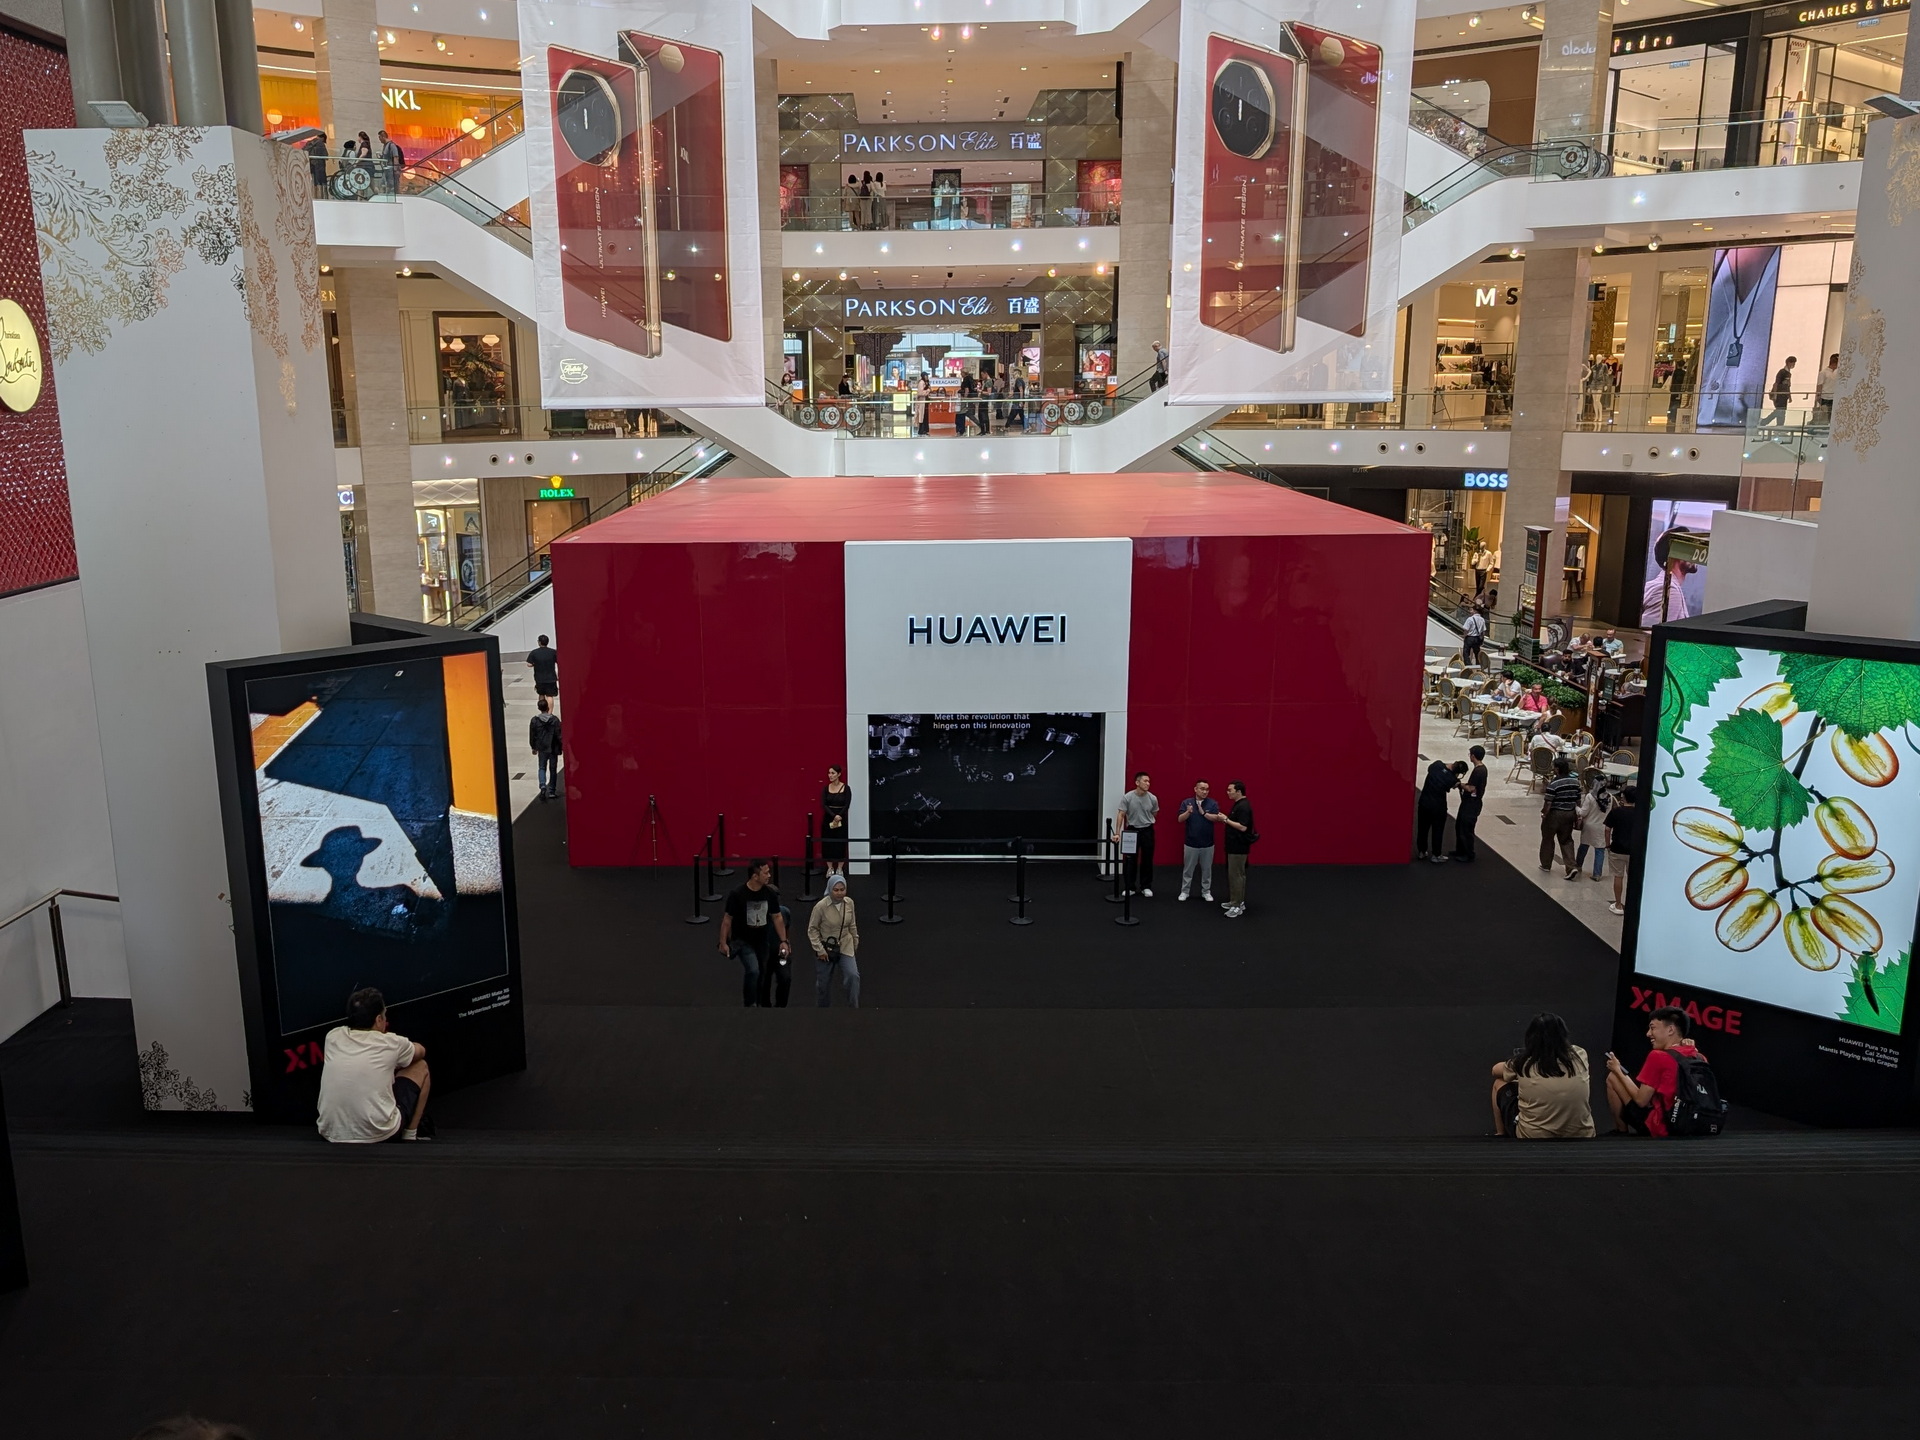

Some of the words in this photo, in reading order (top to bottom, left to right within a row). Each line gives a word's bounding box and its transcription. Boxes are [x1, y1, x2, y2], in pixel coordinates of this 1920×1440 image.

[1799, 3, 1857, 22] CHARLES
[1865, 1, 1873, 10] &
[844, 134, 956, 153] PARKSON
[958, 131, 999, 150] Elite
[1009, 132, 1042, 149] 百盛
[846, 298, 955, 317] PARKSON
[958, 296, 999, 315] Elite
[1007, 297, 1040, 314] 百盛
[1464, 472, 1508, 488] BOSS
[540, 489, 574, 498] ROLEX
[908, 614, 1067, 646] HUAWEI
[933, 722, 958, 730] hinges
[1838, 1037, 1864, 1048] HUAWEI
[1864, 1043, 1879, 1051] Pura
[1818, 1045, 1838, 1054] Mantis
[1839, 1051, 1861, 1060] Playing
[1877, 1059, 1898, 1068] Grapes
[1875, 1052, 1898, 1063] Zehong
